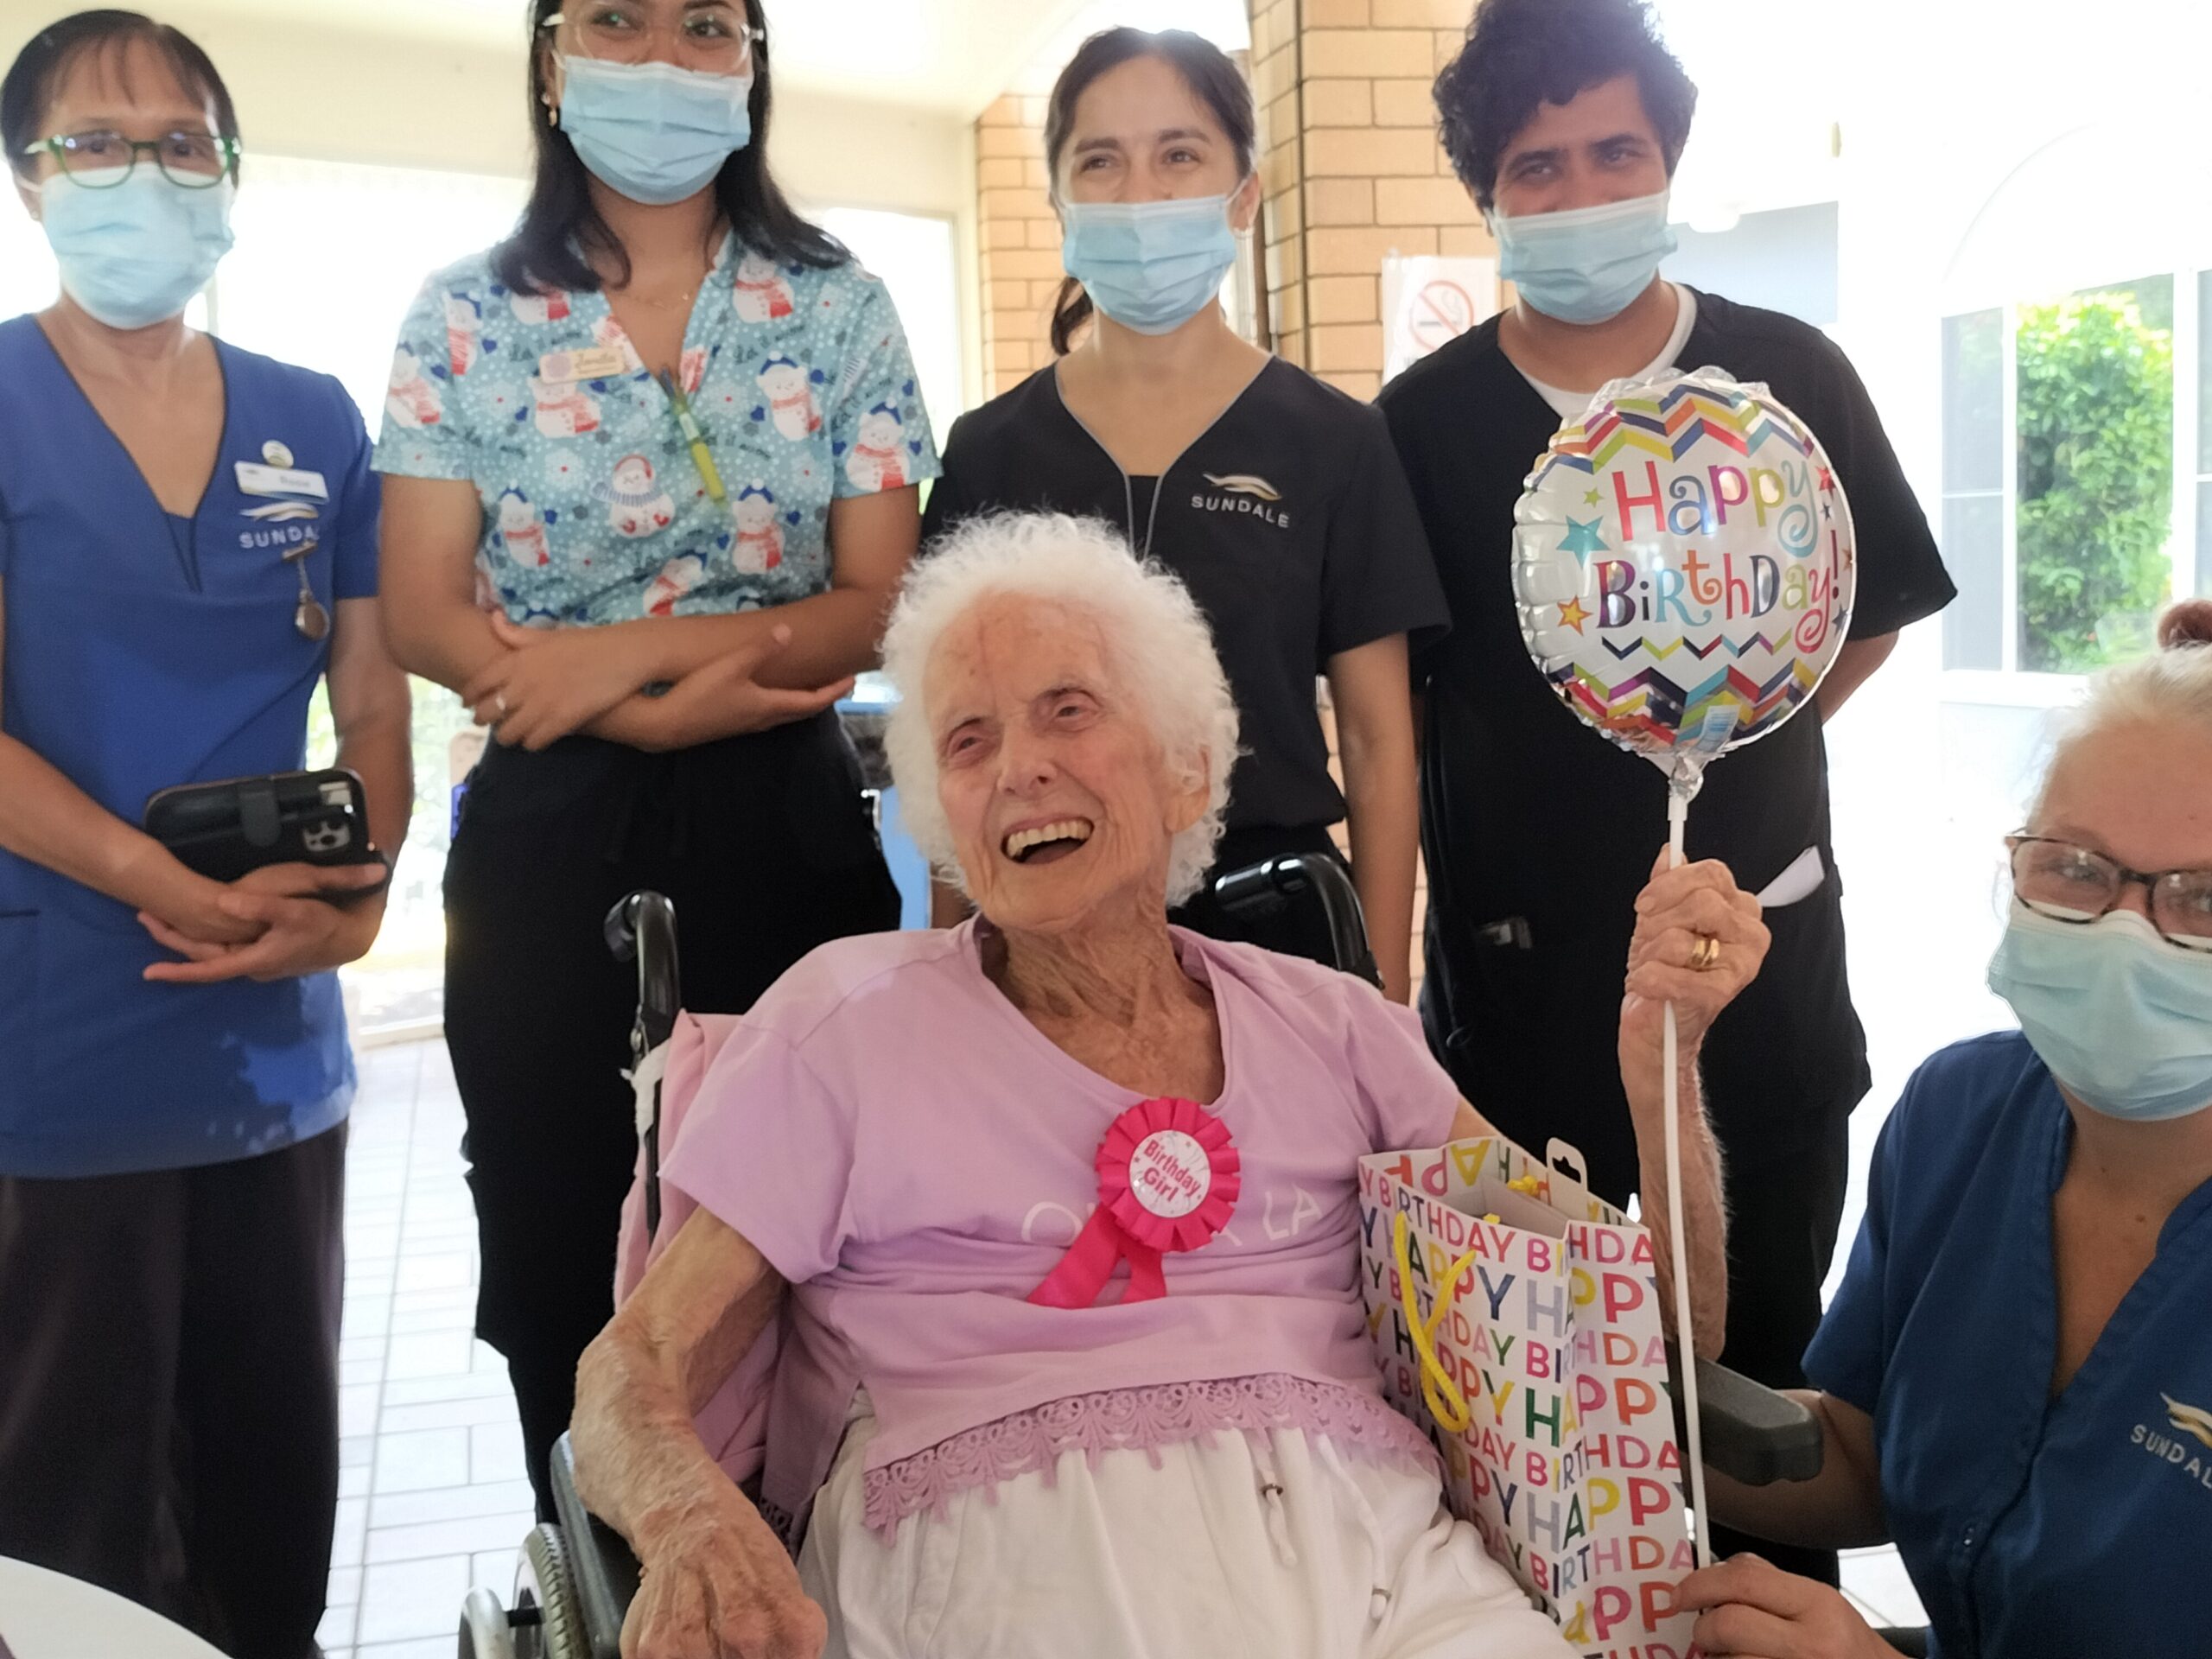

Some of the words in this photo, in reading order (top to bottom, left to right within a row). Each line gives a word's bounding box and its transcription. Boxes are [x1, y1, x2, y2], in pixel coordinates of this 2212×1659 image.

[238, 524, 320, 549] SUNDA
[1191, 495, 1290, 528] SUNDALE
[1611, 460, 1819, 558] Happy
[1143, 1140, 1202, 1198] Birthday
[1143, 1166, 1179, 1202] Girl
[1526, 1330, 1668, 1384] BIRTHDA
[1525, 1374, 1673, 1449] HAPP
[1525, 1433, 1681, 1494] BIRTHDA
[2130, 1424, 2212, 1490] SUNDAL
[1526, 1476, 1685, 1554] HAPP
[1529, 1535, 1694, 1599] BIRTHDA
